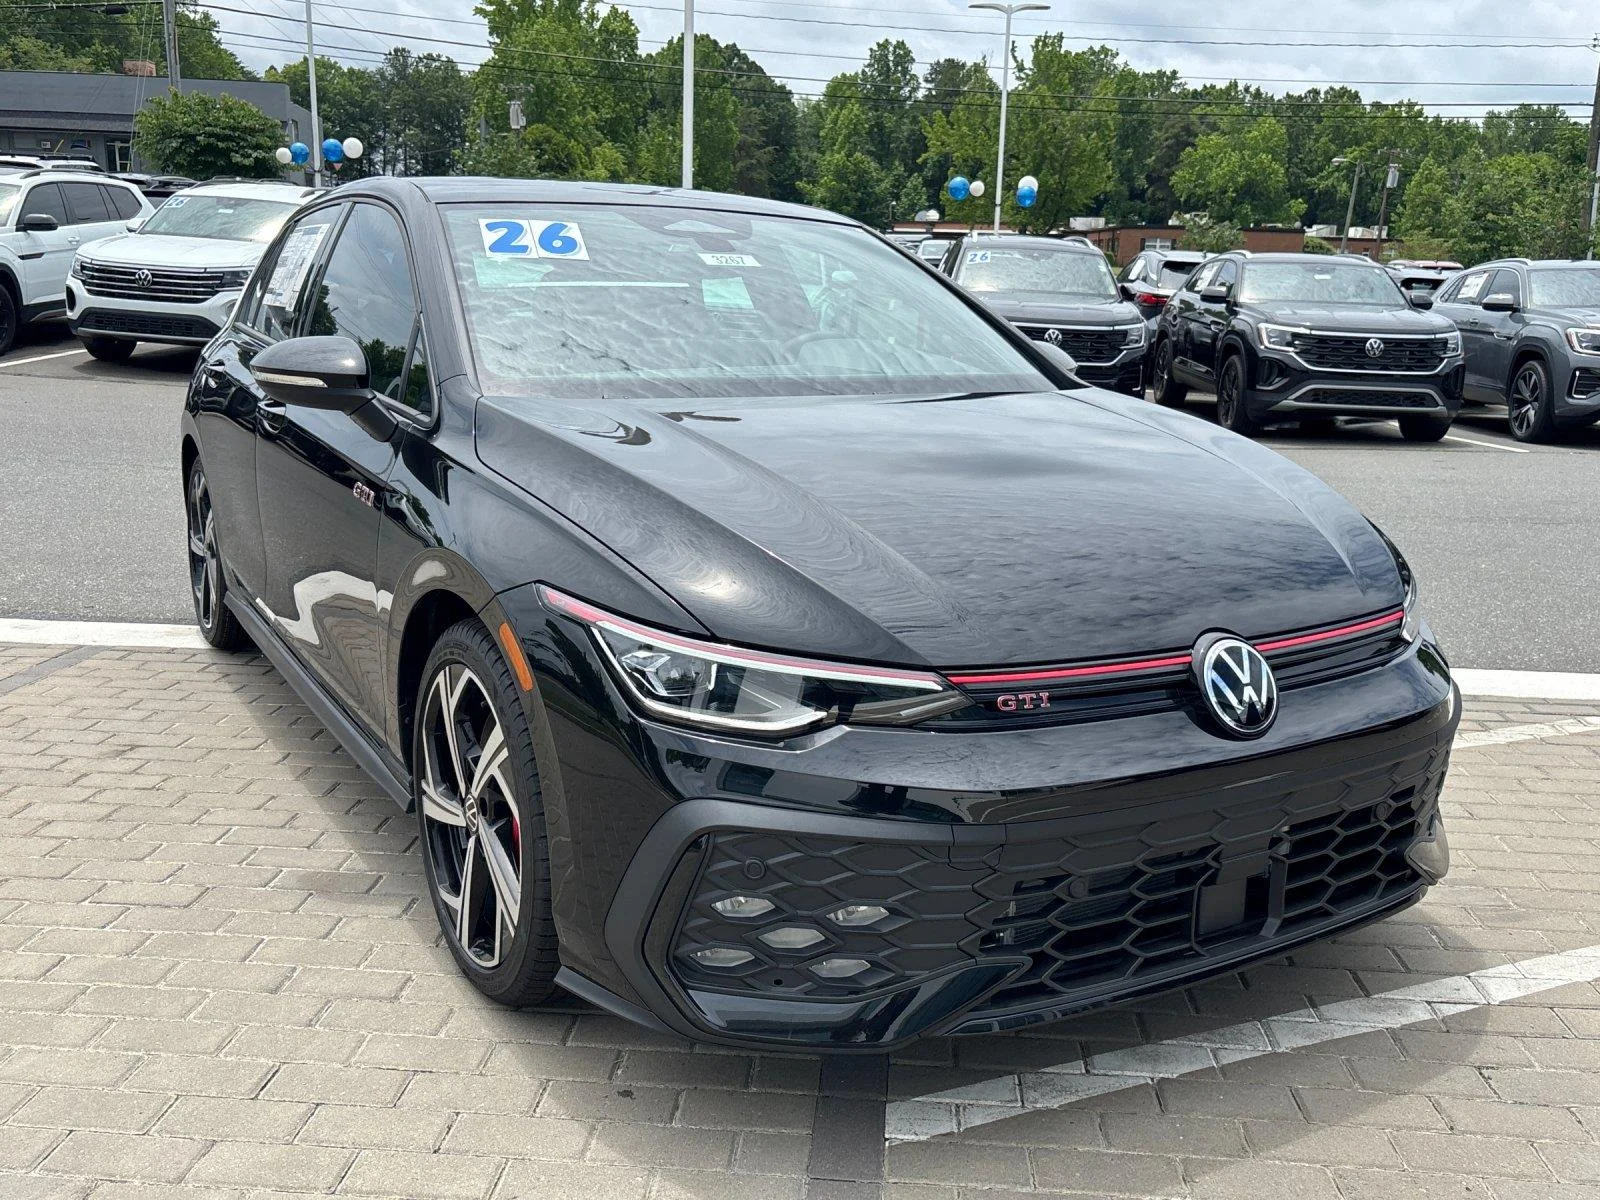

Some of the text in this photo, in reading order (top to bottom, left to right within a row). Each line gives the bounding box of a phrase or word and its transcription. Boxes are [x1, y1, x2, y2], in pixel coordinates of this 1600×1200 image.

[485, 221, 579, 256] 26
[969, 252, 989, 263] 26
[353, 481, 375, 507] GTI
[1207, 642, 1272, 726] VW
[997, 691, 1051, 711] GTI
